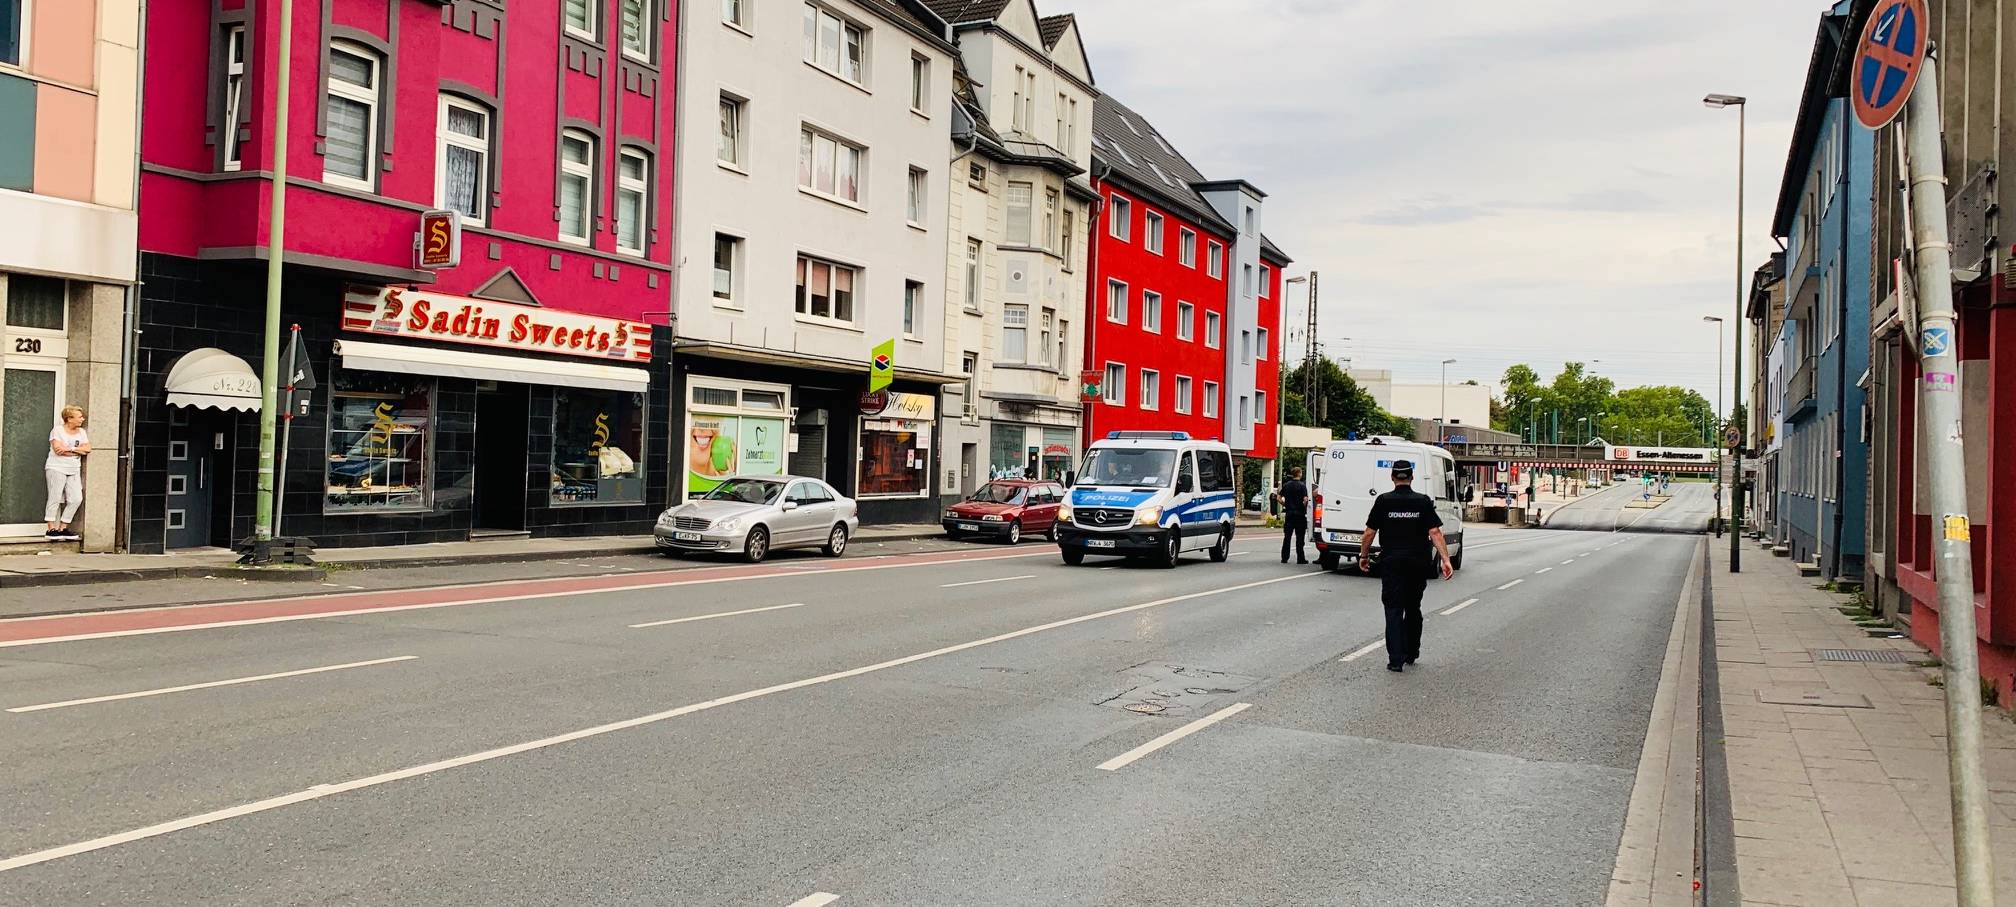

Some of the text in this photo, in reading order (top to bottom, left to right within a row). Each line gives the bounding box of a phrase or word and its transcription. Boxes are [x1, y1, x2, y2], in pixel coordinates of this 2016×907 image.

[428, 220, 448, 253] S
[407, 299, 500, 339] Sadin
[508, 313, 610, 352] Sweets
[15, 337, 41, 354] 230
[861, 397, 880, 405] STRIKE
[1331, 450, 1345, 460] 60
[1616, 449, 1628, 458] DB
[1636, 450, 1704, 460] Essen-Altenessen
[1497, 461, 1507, 472] U
[1084, 495, 1130, 503] POLIZEI
[1388, 511, 1421, 519] ORDNUNGSAMT
